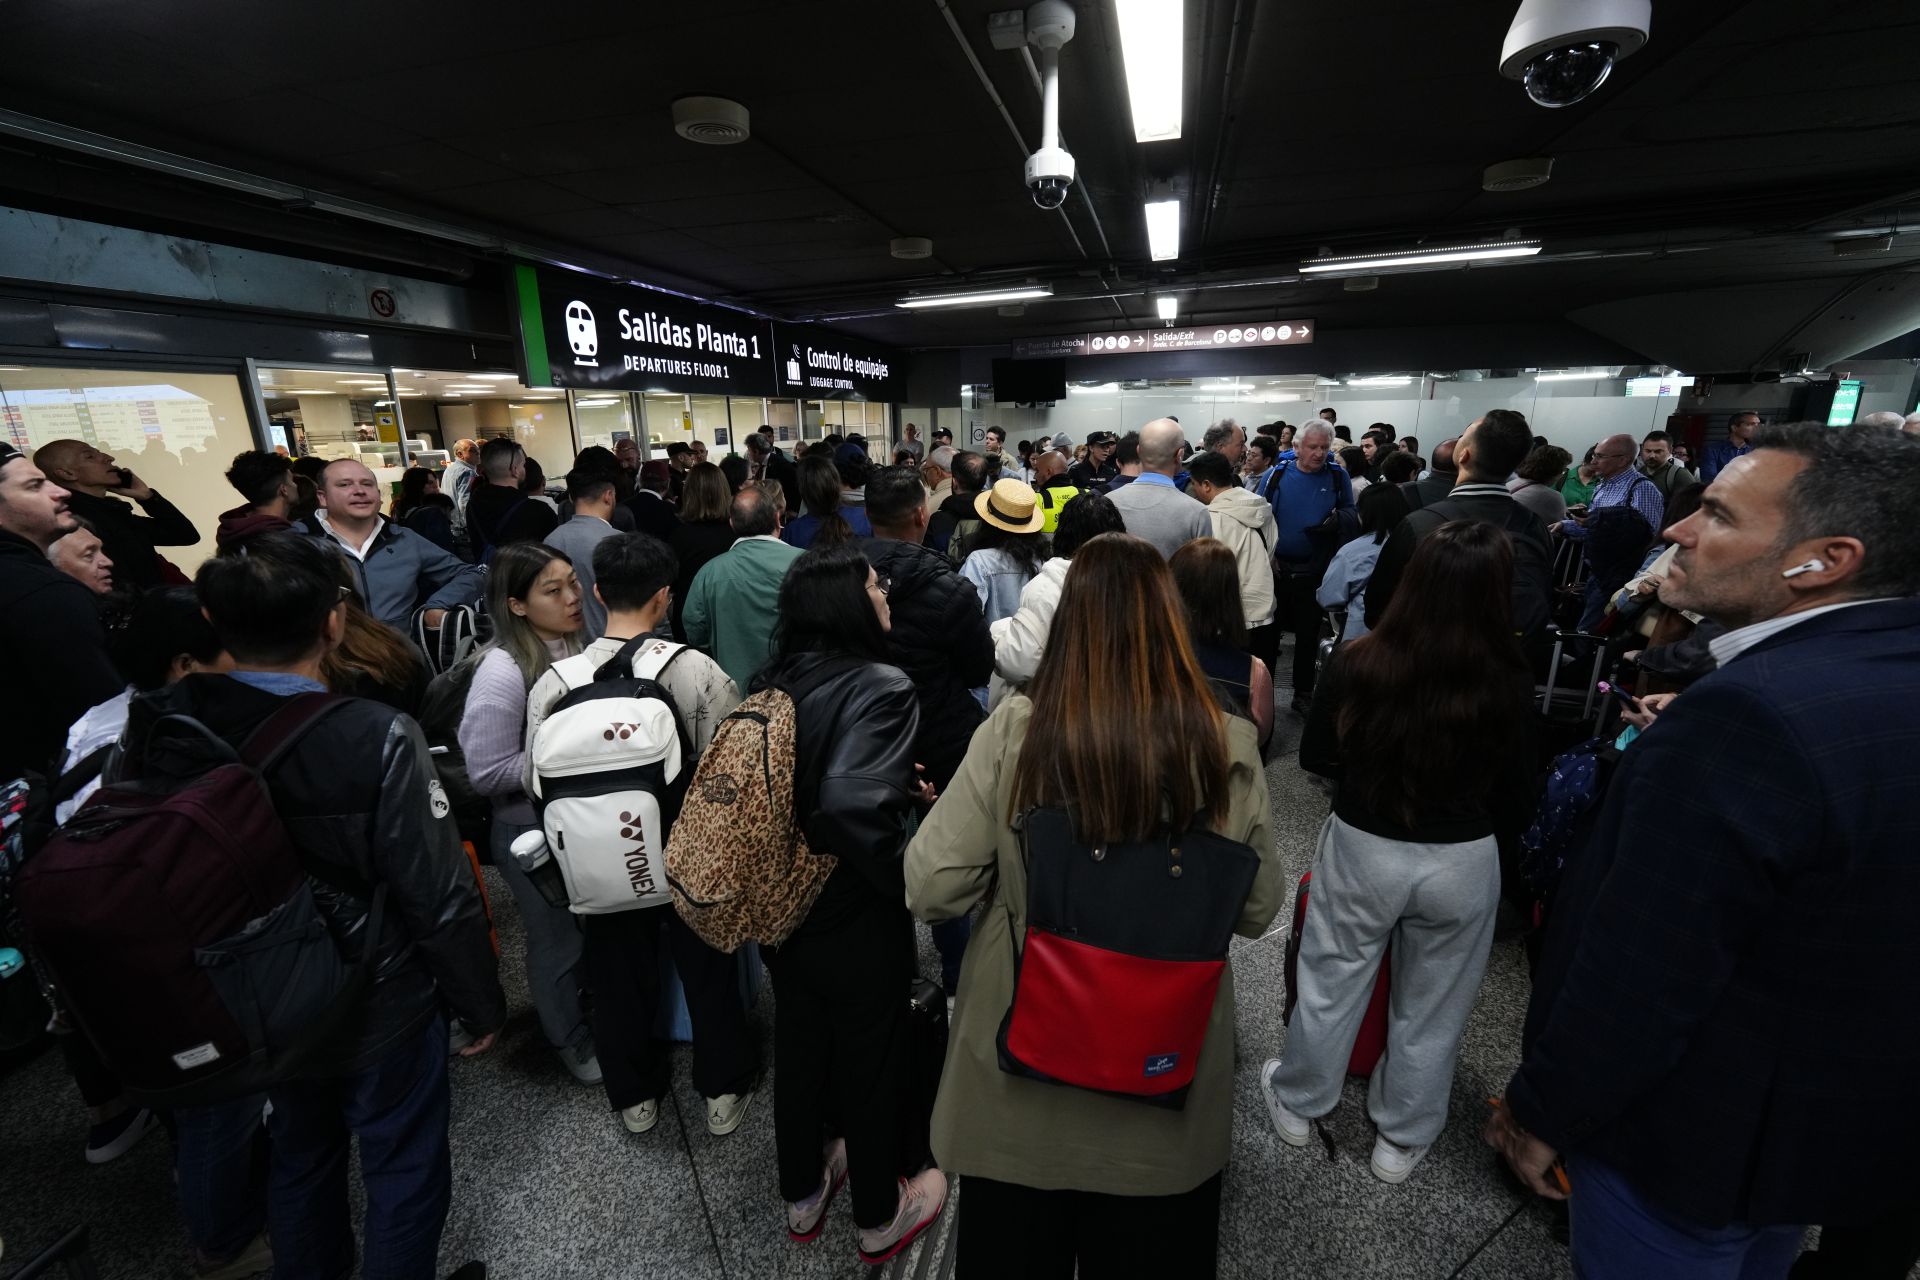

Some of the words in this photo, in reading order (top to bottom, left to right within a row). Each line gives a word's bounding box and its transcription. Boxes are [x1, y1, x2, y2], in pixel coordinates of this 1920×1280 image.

[618, 308, 692, 349] Salidas
[696, 323, 748, 357] Planta
[751, 335, 761, 359] 1
[1051, 339, 1060, 348] de
[1061, 338, 1085, 347] Atocha
[1153, 331, 1195, 342] Salida/Exit
[624, 354, 692, 376] DEPARTURES
[693, 362, 722, 378] FLOOR
[723, 365, 730, 378] 1
[807, 346, 841, 371] Control
[843, 353, 854, 372] de
[855, 356, 889, 380] equipajes
[809, 376, 833, 388] LUGGAGE
[834, 379, 854, 390] CONTROL
[624, 845, 658, 898] YONEX
